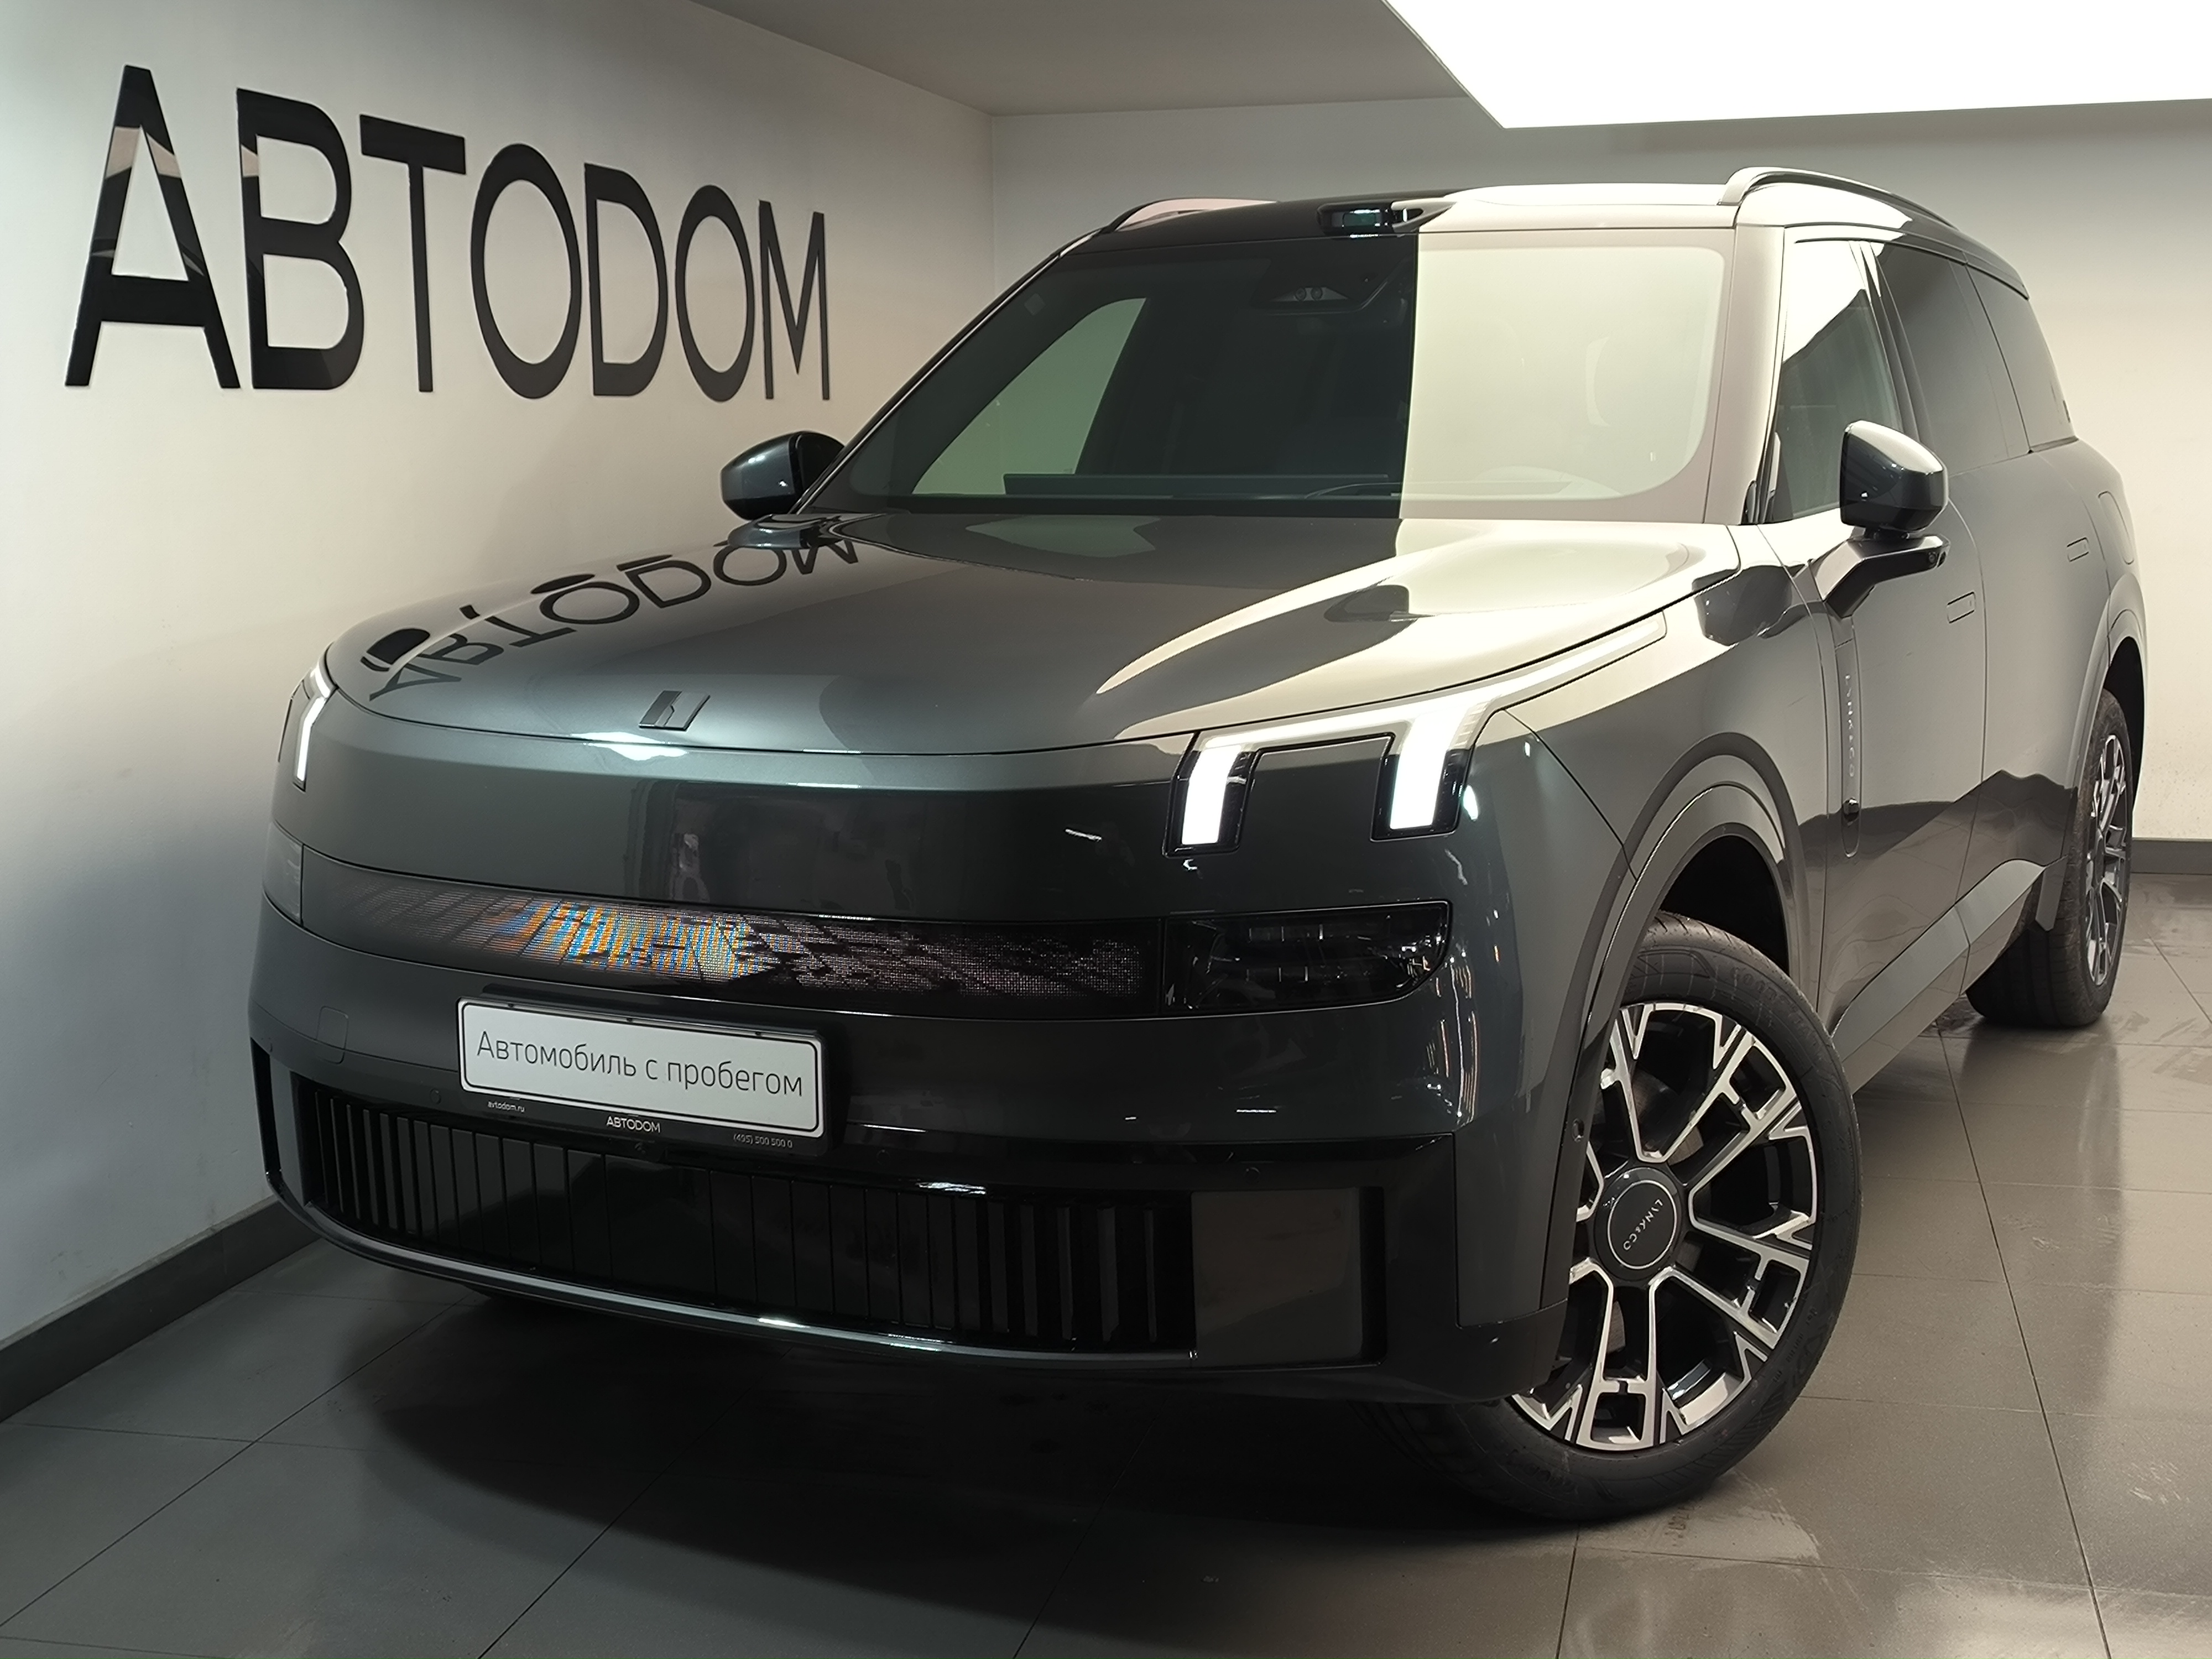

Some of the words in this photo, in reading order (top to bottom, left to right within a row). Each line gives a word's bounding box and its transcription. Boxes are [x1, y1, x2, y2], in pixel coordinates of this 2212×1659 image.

[477, 1030, 637, 1077] Автомобиль
[645, 1059, 658, 1079] с
[667, 1061, 803, 1097] пробегом
[488, 1101, 525, 1113] avtodom.ru
[733, 1133, 753, 1144] (495)
[755, 1136, 769, 1145] 500
[771, 1138, 785, 1147] 500
